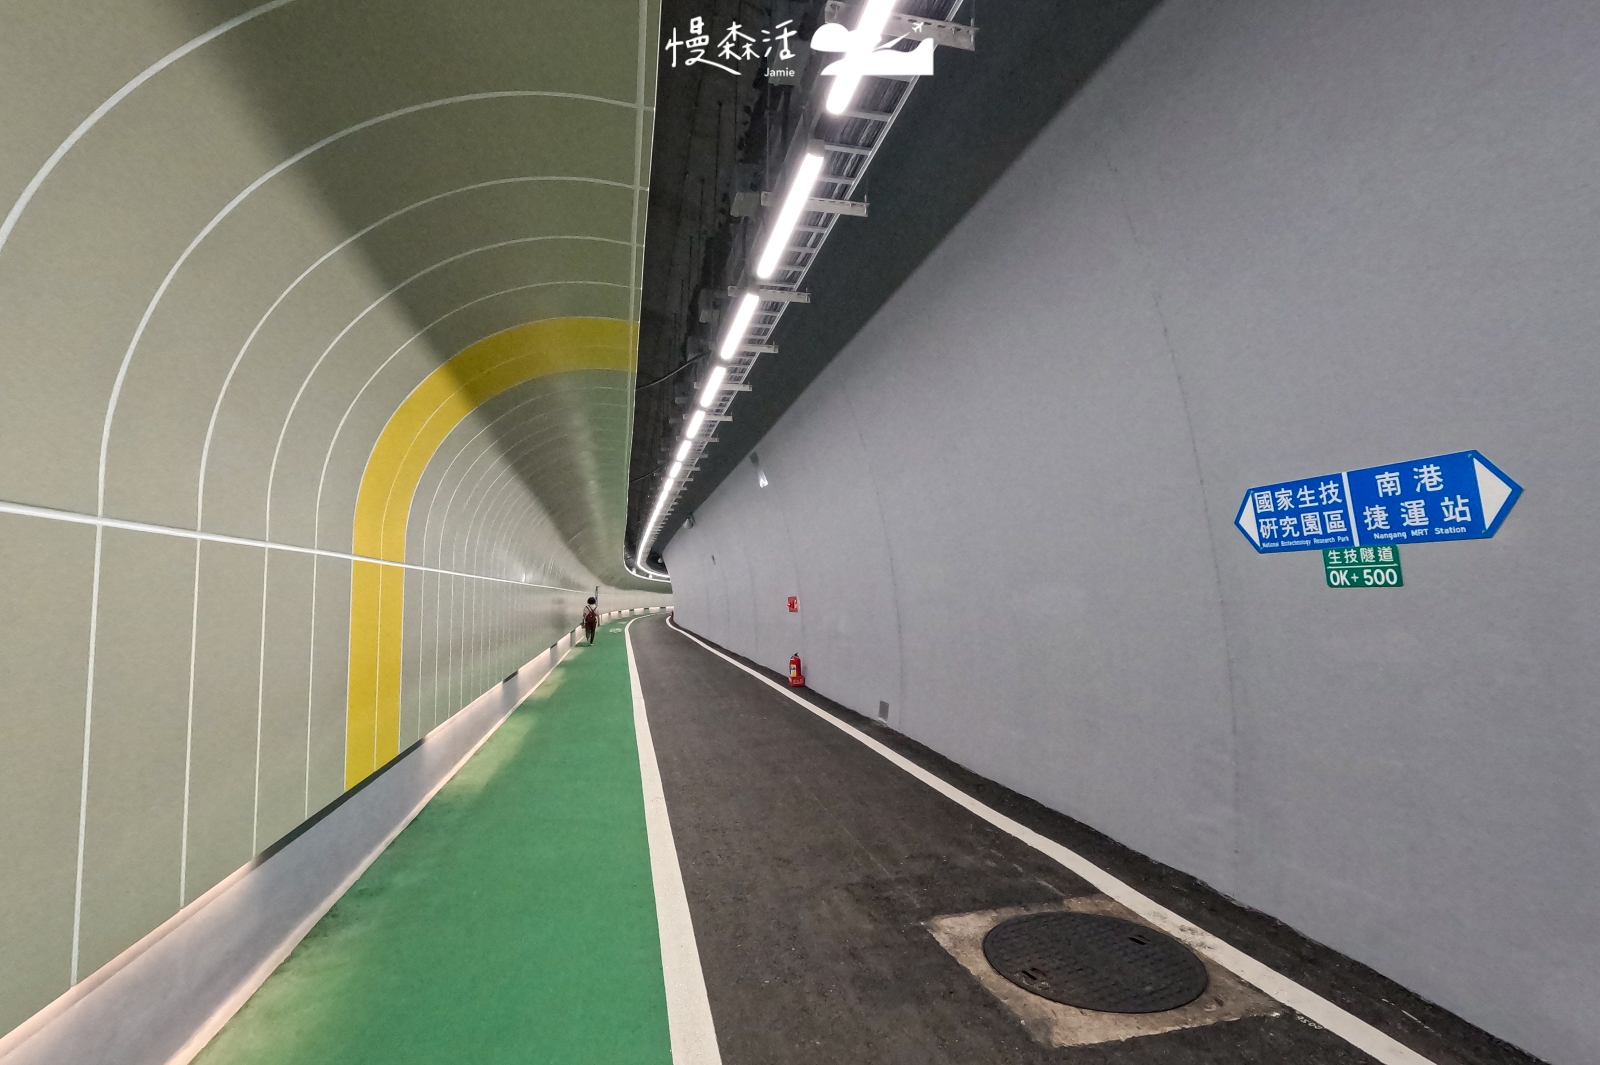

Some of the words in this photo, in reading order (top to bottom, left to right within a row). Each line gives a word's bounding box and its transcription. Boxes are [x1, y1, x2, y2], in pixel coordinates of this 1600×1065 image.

[1254, 480, 1343, 513] 國家生技
[1375, 464, 1444, 498] 南港
[1259, 509, 1348, 539] 研究園區
[1363, 495, 1472, 531] 捷運站
[1374, 531, 1407, 540] Nangang
[1411, 528, 1429, 536] MRT
[1434, 526, 1467, 535] Station
[1328, 546, 1394, 564] 生技隧道
